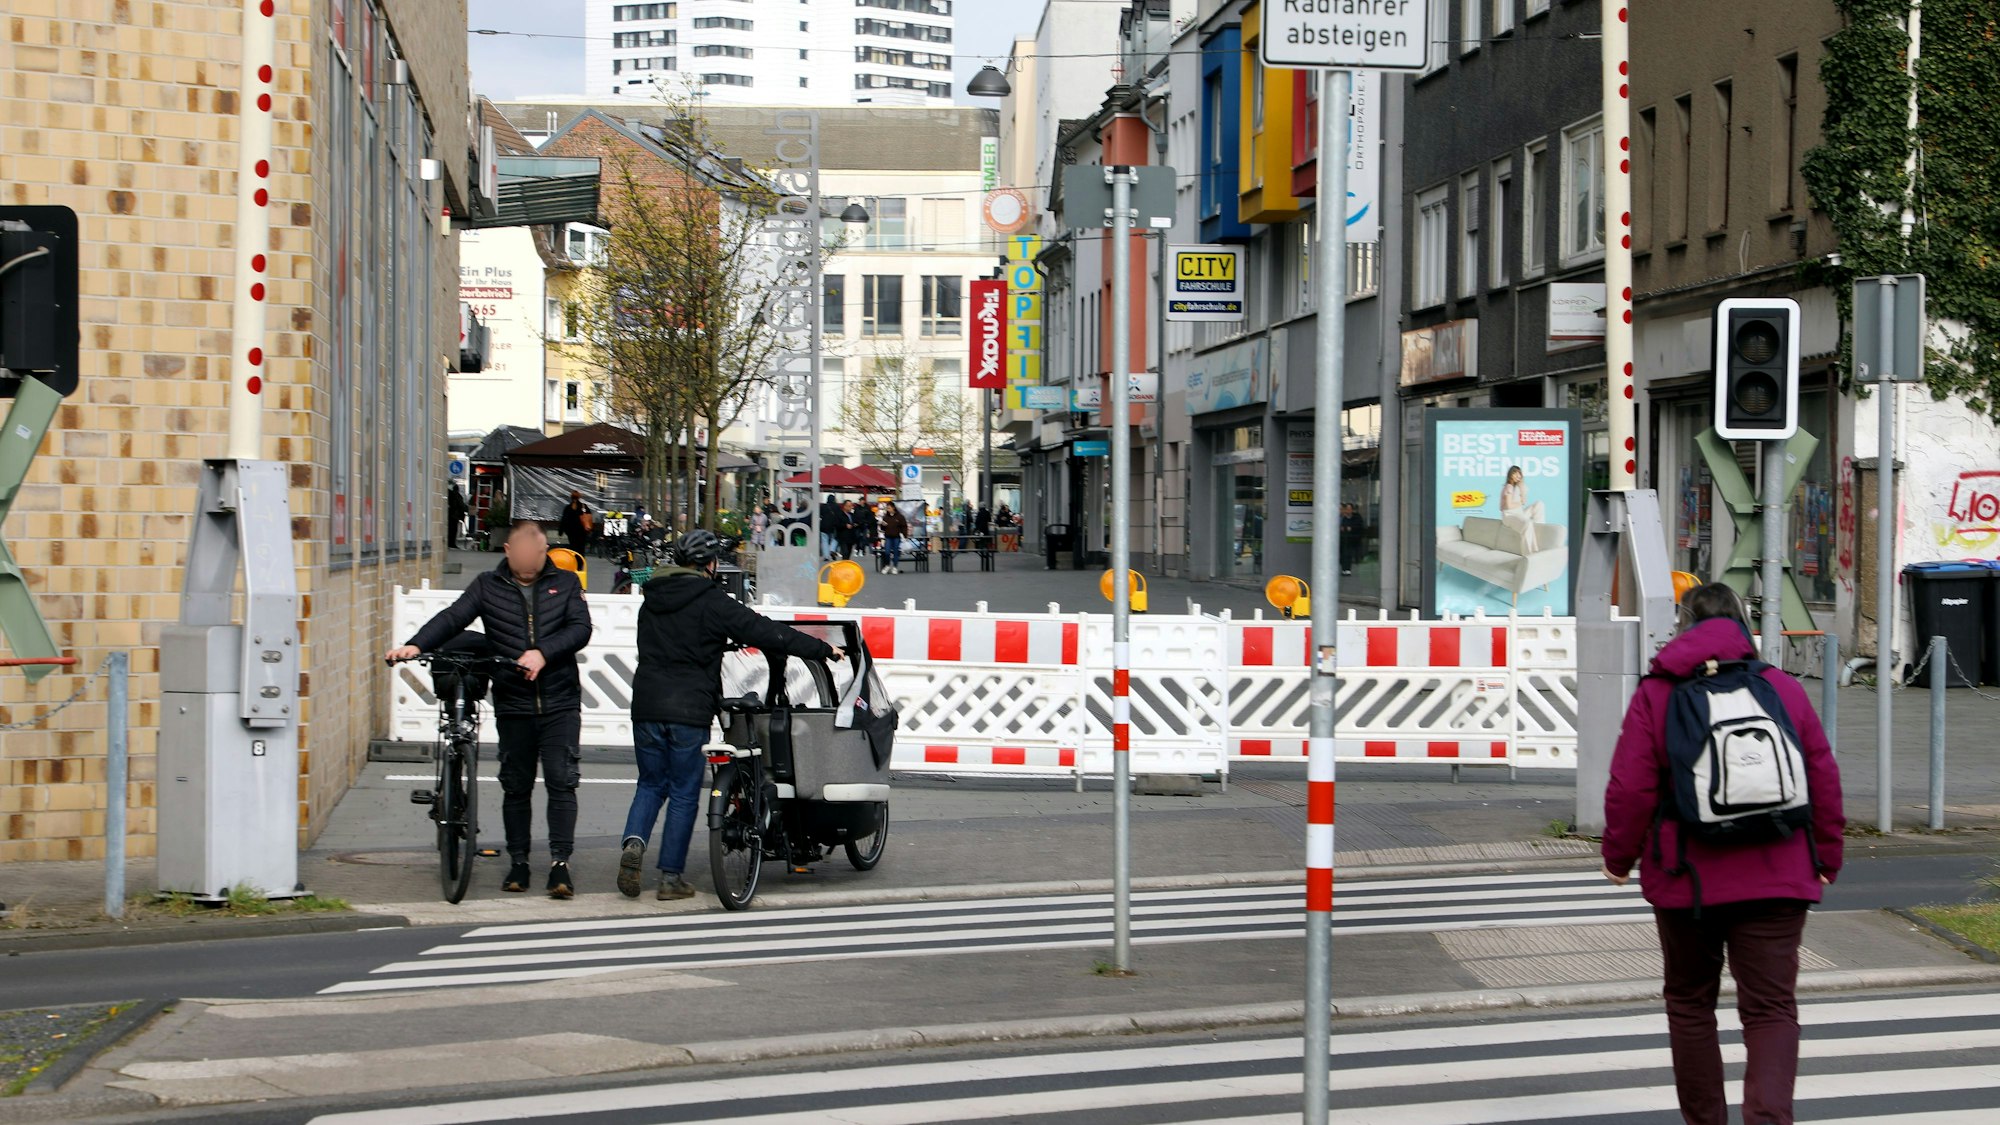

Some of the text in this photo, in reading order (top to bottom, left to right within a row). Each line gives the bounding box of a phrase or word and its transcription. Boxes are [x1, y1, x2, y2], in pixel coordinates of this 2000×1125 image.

[1284, 0, 1409, 16] Radfahrer
[1287, 22, 1407, 52] absteigen
[460, 266, 512, 277] Ein Plus
[1181, 257, 1231, 276] CITY
[1180, 282, 1232, 291] FAHRSCHULE
[1173, 302, 1237, 312] cityfahrschule.de
[1443, 433, 1513, 455] BEST
[253, 741, 264, 755] 8
